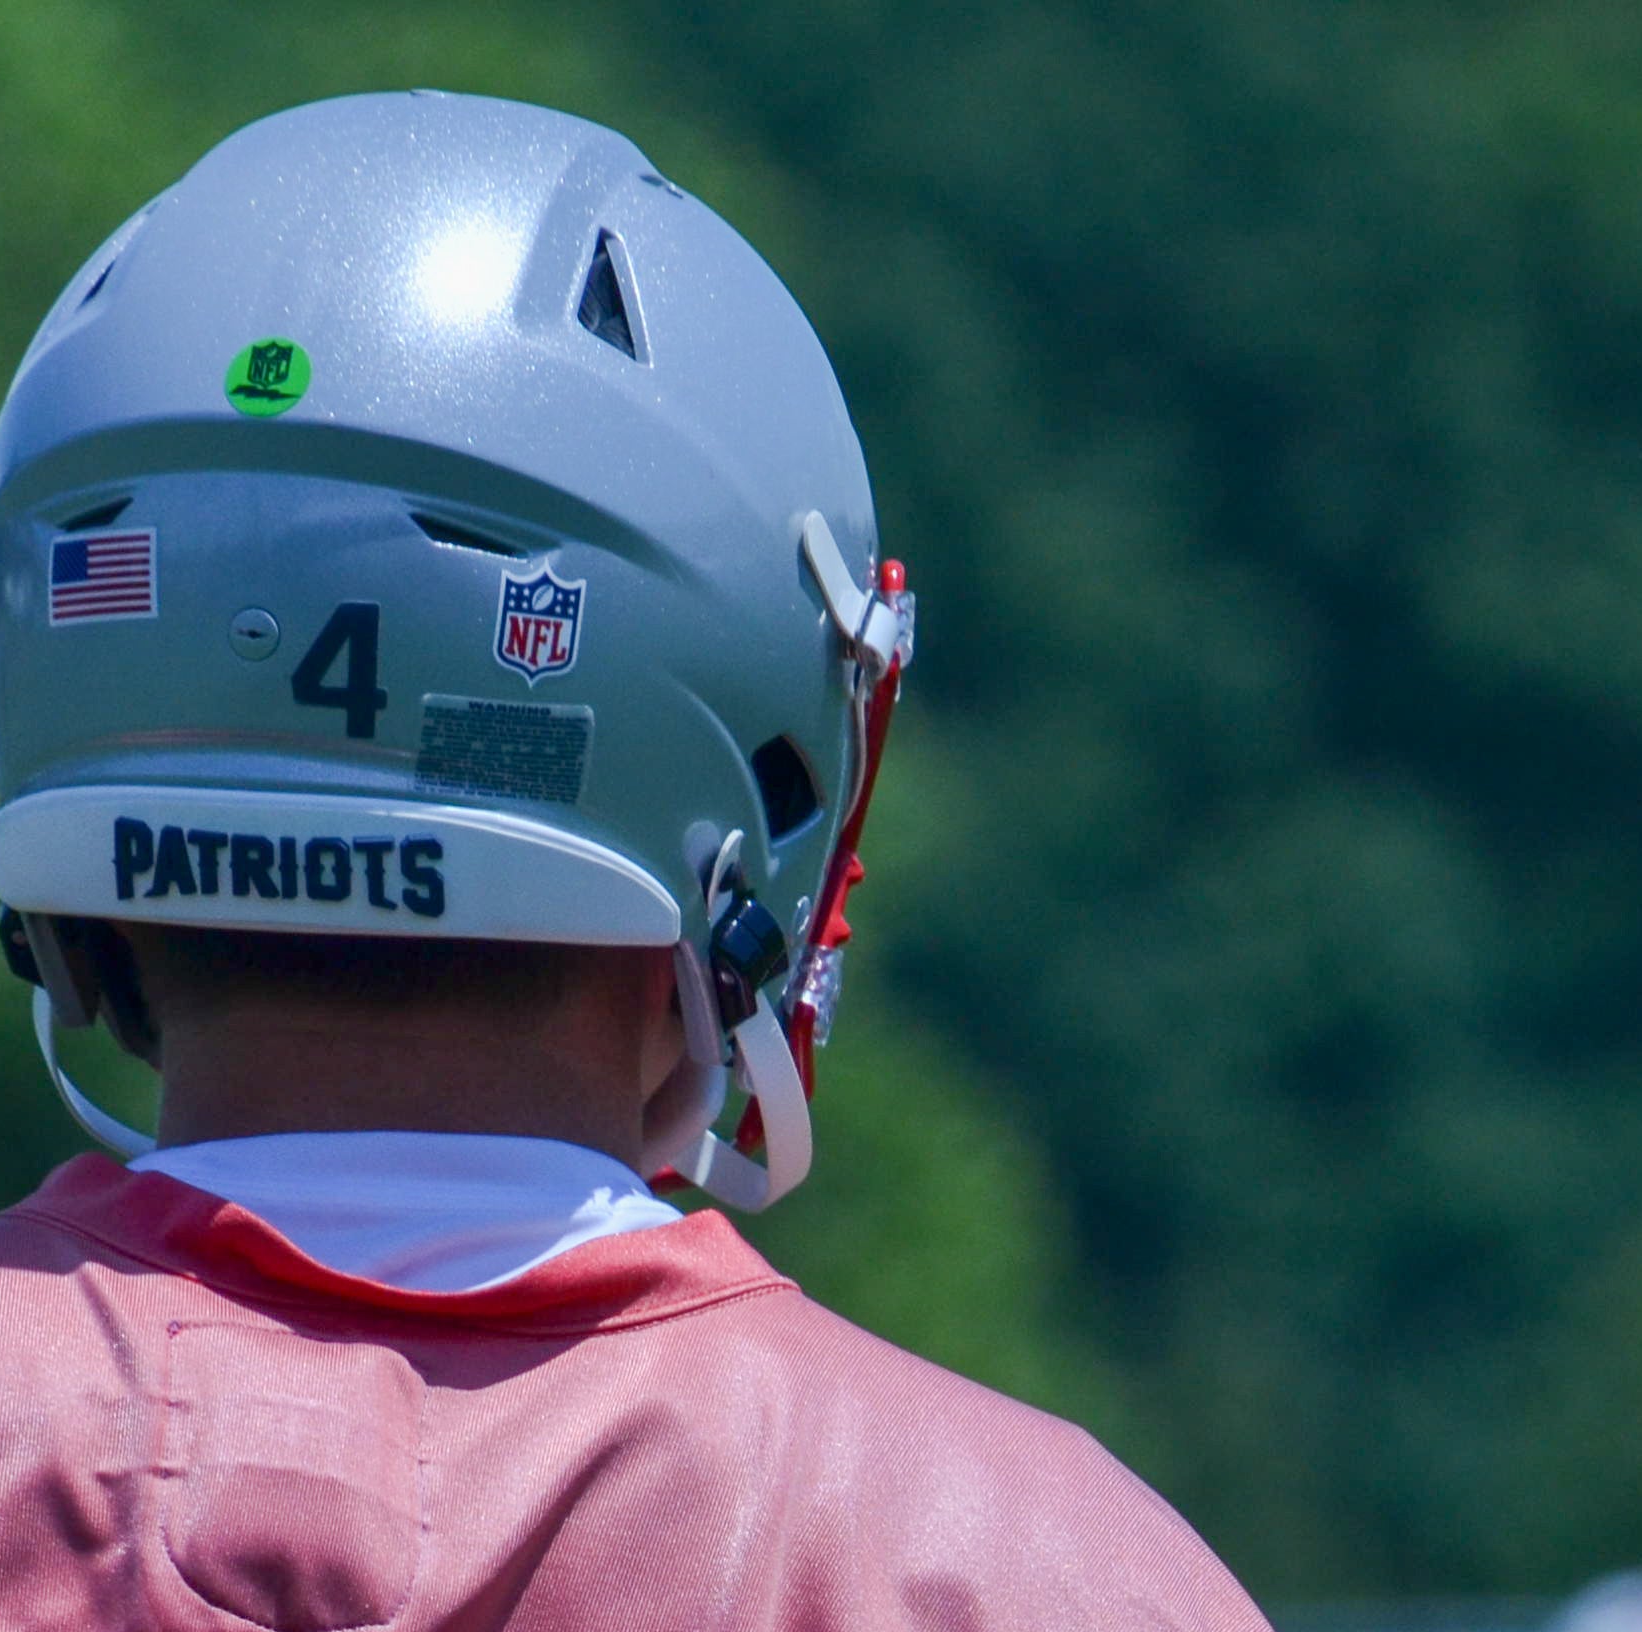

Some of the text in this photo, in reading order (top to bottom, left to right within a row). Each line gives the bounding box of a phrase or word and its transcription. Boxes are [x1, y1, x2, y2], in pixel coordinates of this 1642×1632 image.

[251, 360, 288, 383] NFL
[504, 615, 567, 667] NFL
[291, 602, 387, 739] 4
[469, 701, 551, 716] WARNING
[113, 816, 445, 918] PATRIOTS
